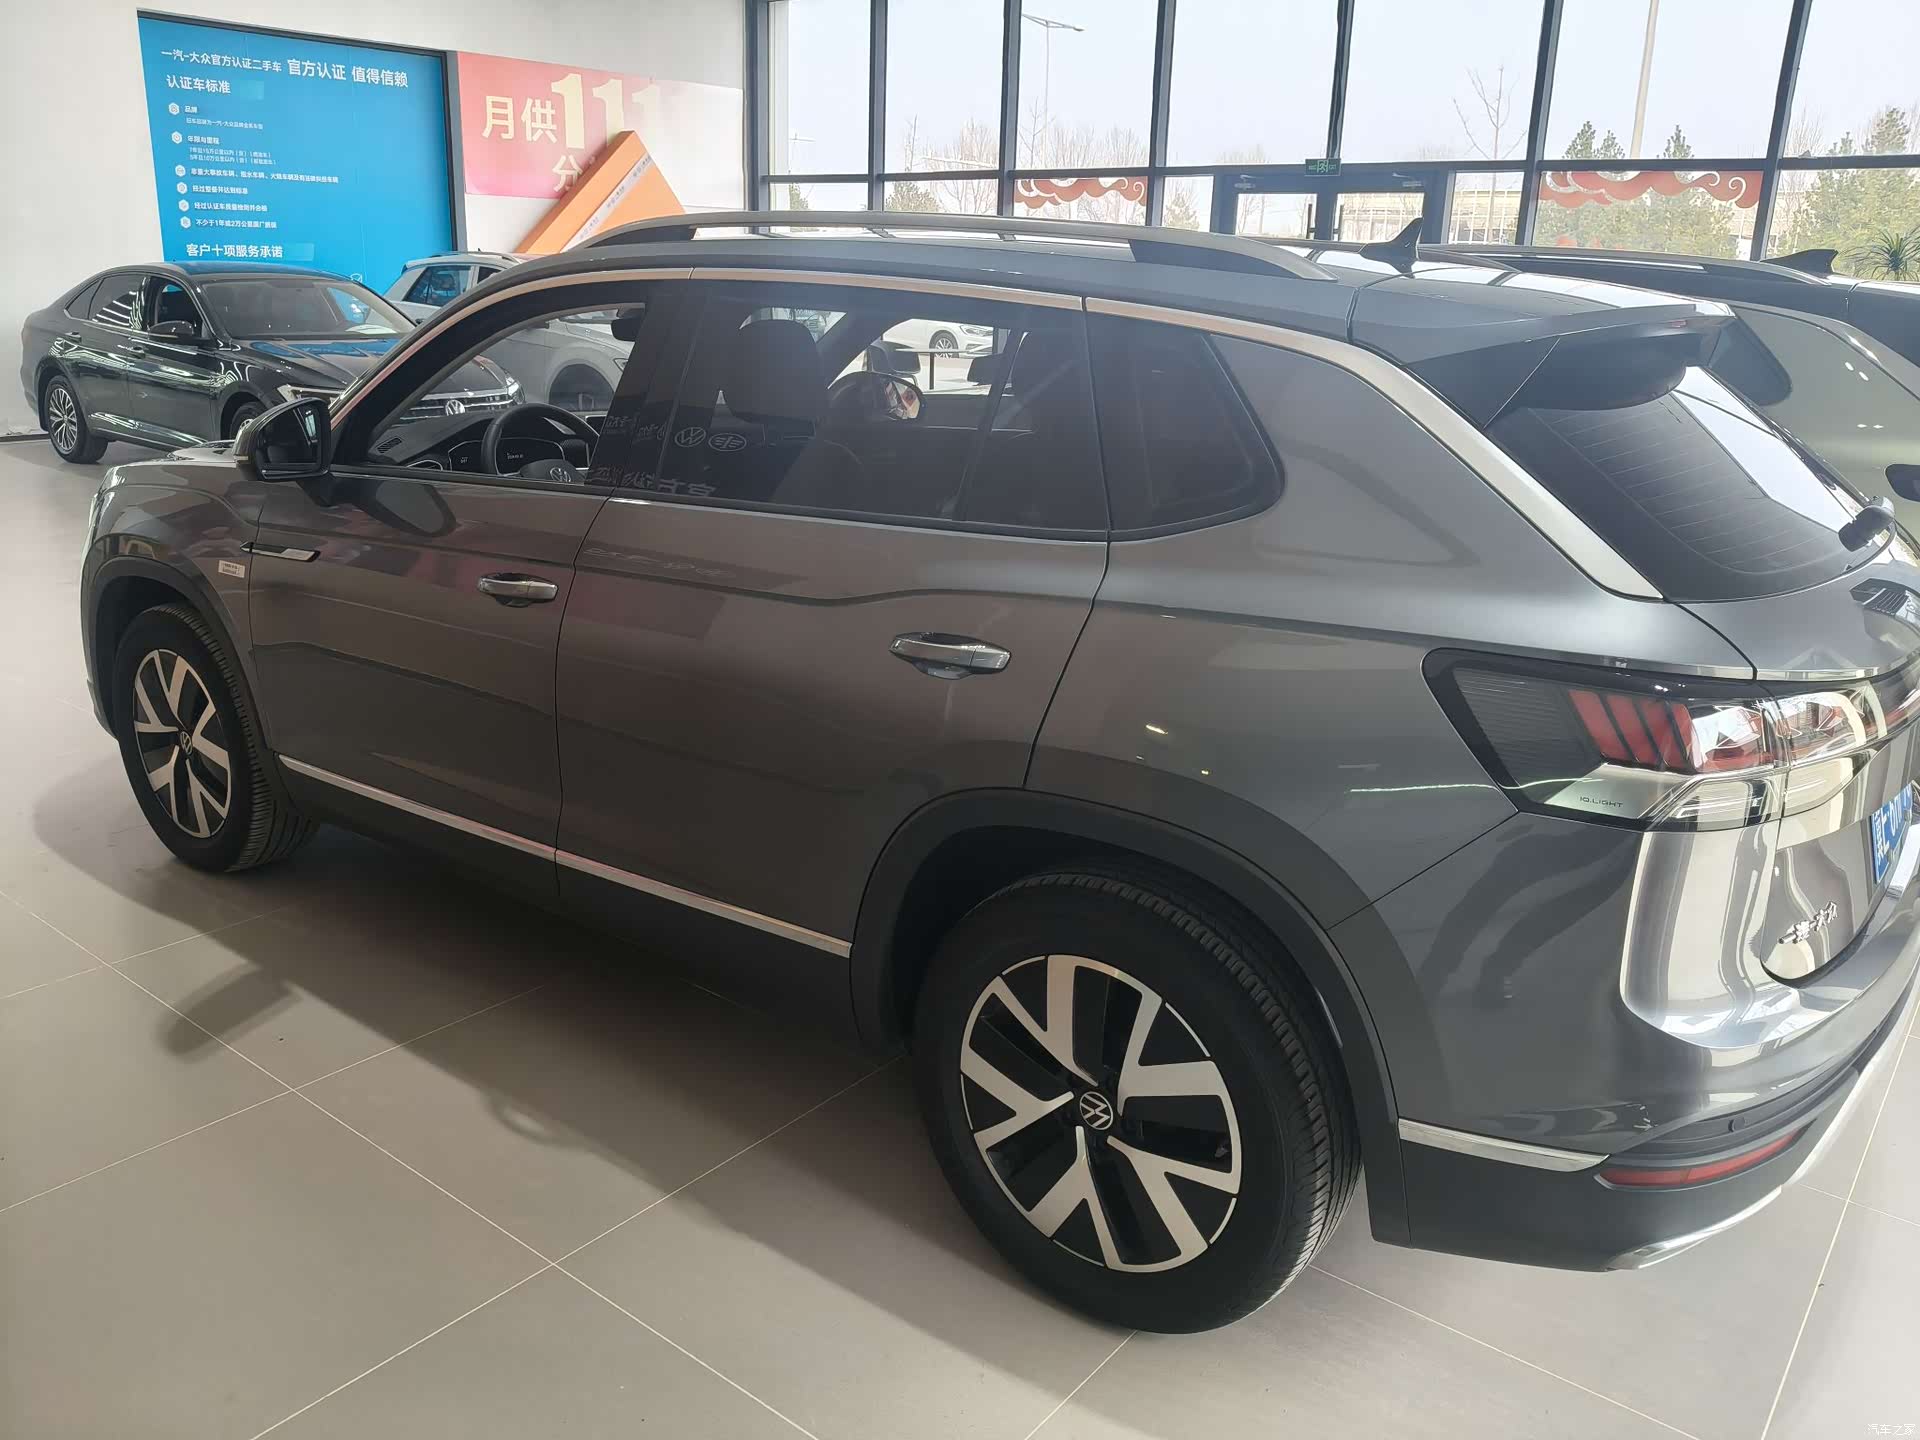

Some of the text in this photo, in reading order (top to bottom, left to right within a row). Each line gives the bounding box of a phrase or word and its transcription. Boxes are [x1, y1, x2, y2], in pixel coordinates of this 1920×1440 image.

[161, 49, 408, 88] 一汽-大众官方认证二手车 官方认证 值得信赖
[166, 75, 231, 94] 认证车标准
[186, 243, 283, 258] 客户十项服务承诺
[1580, 796, 1623, 808] IQ.LIGHT
